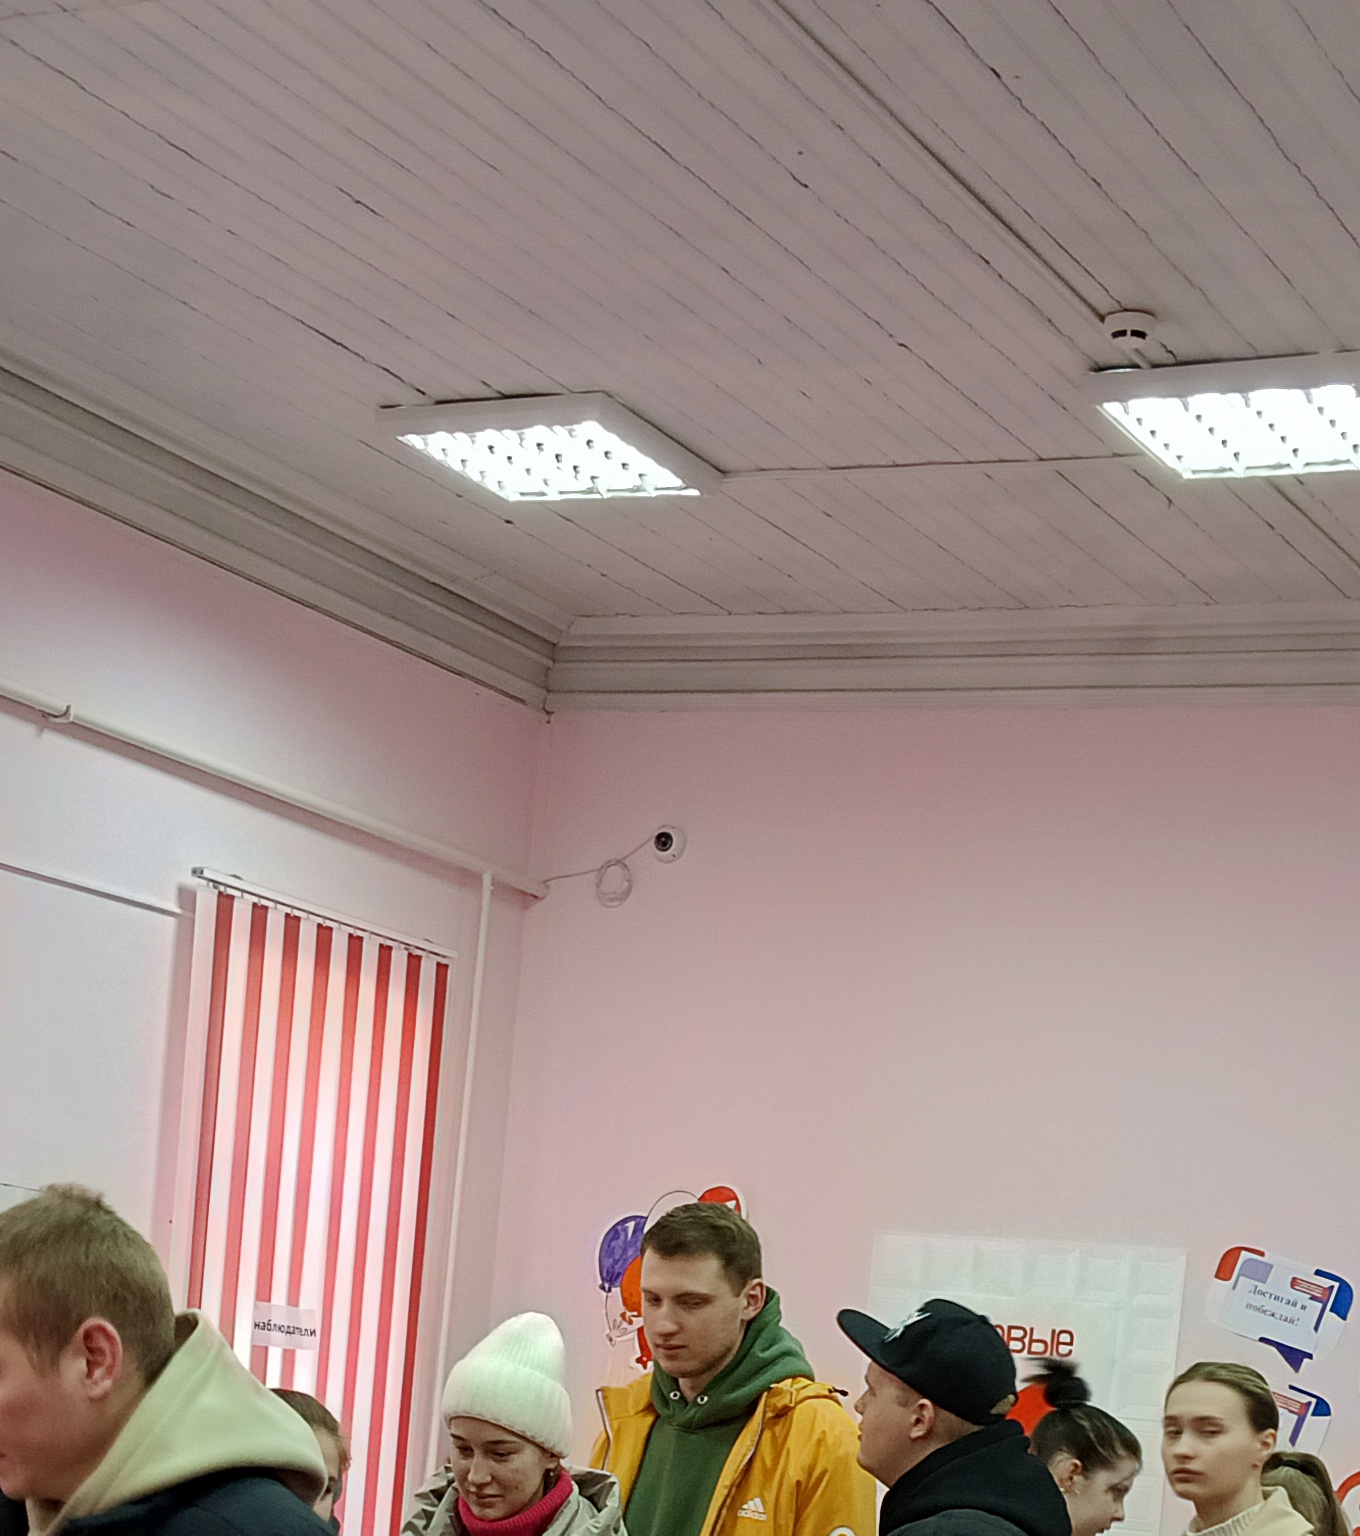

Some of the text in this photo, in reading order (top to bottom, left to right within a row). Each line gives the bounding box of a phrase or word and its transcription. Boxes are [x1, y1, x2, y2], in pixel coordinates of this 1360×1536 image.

[1248, 1284, 1299, 1308] Достигай
[1300, 1302, 1308, 1312] и
[1245, 1302, 1300, 1327] побеждай!
[253, 1319, 317, 1338] наблюдатели
